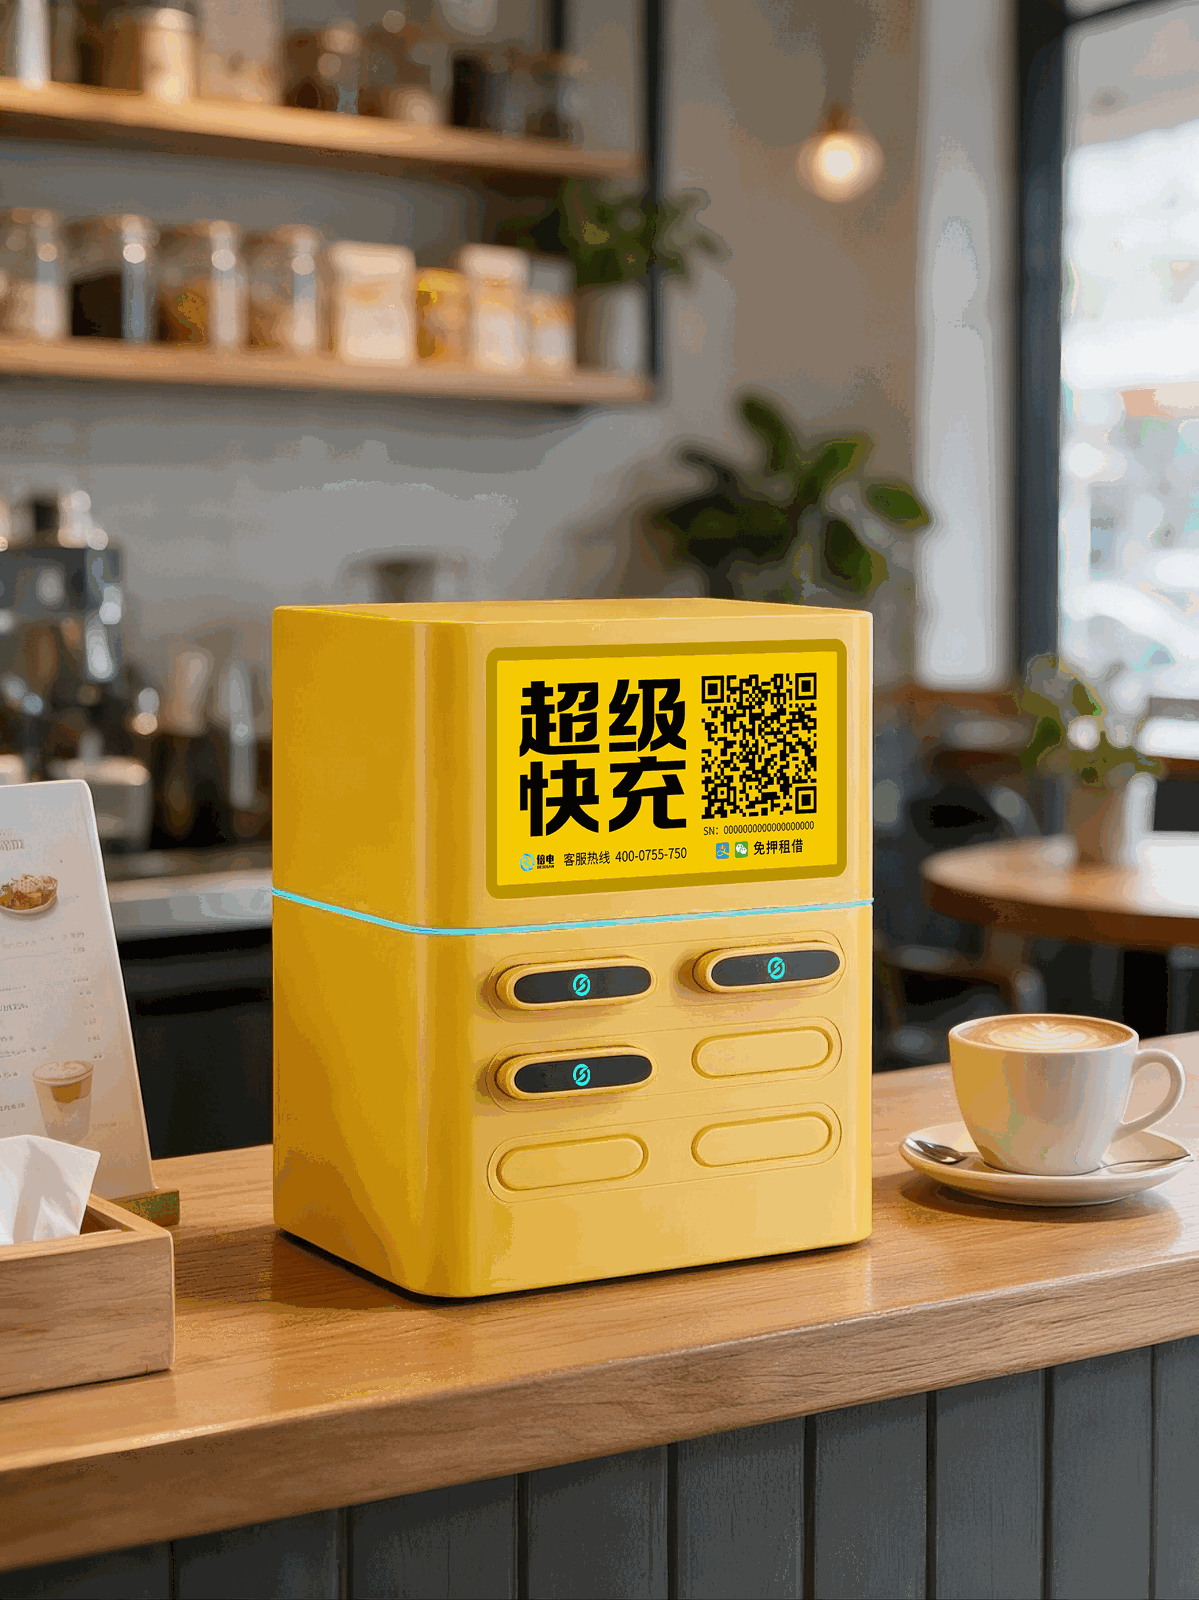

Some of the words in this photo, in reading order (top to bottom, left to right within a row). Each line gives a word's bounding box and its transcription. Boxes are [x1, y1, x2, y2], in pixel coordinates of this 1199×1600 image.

[520, 678, 686, 757] 超级
[520, 755, 686, 837] 快充
[563, 850, 611, 867] 客服热线
[615, 846, 688, 863] 400-0755-750
[753, 838, 804, 856] 免押租借
